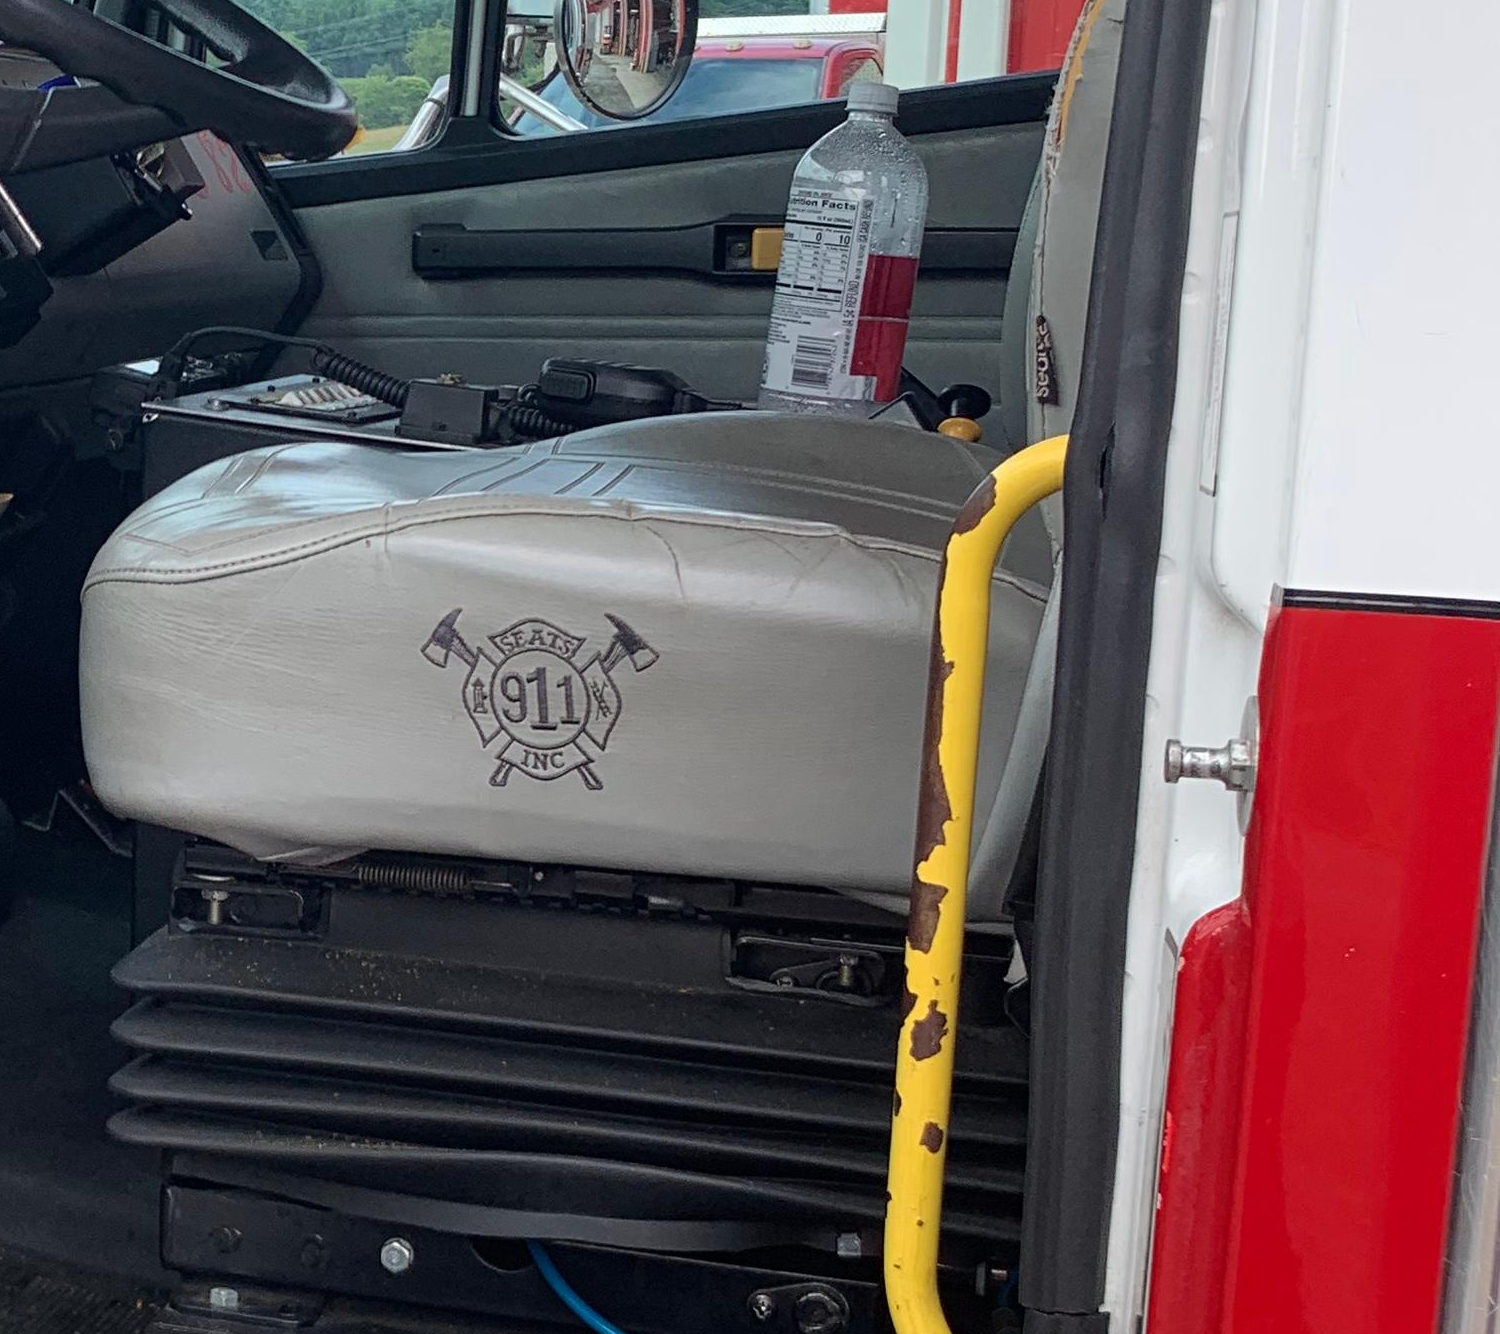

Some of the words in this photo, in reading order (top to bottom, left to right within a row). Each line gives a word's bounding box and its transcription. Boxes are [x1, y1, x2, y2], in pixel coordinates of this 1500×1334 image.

[822, 200, 856, 210] Facts
[816, 232, 822, 241] 0
[840, 235, 850, 244] 10
[844, 280, 859, 308] REFUND
[500, 628, 576, 655] SEATS
[500, 666, 581, 731] 911
[521, 749, 565, 771] INC
